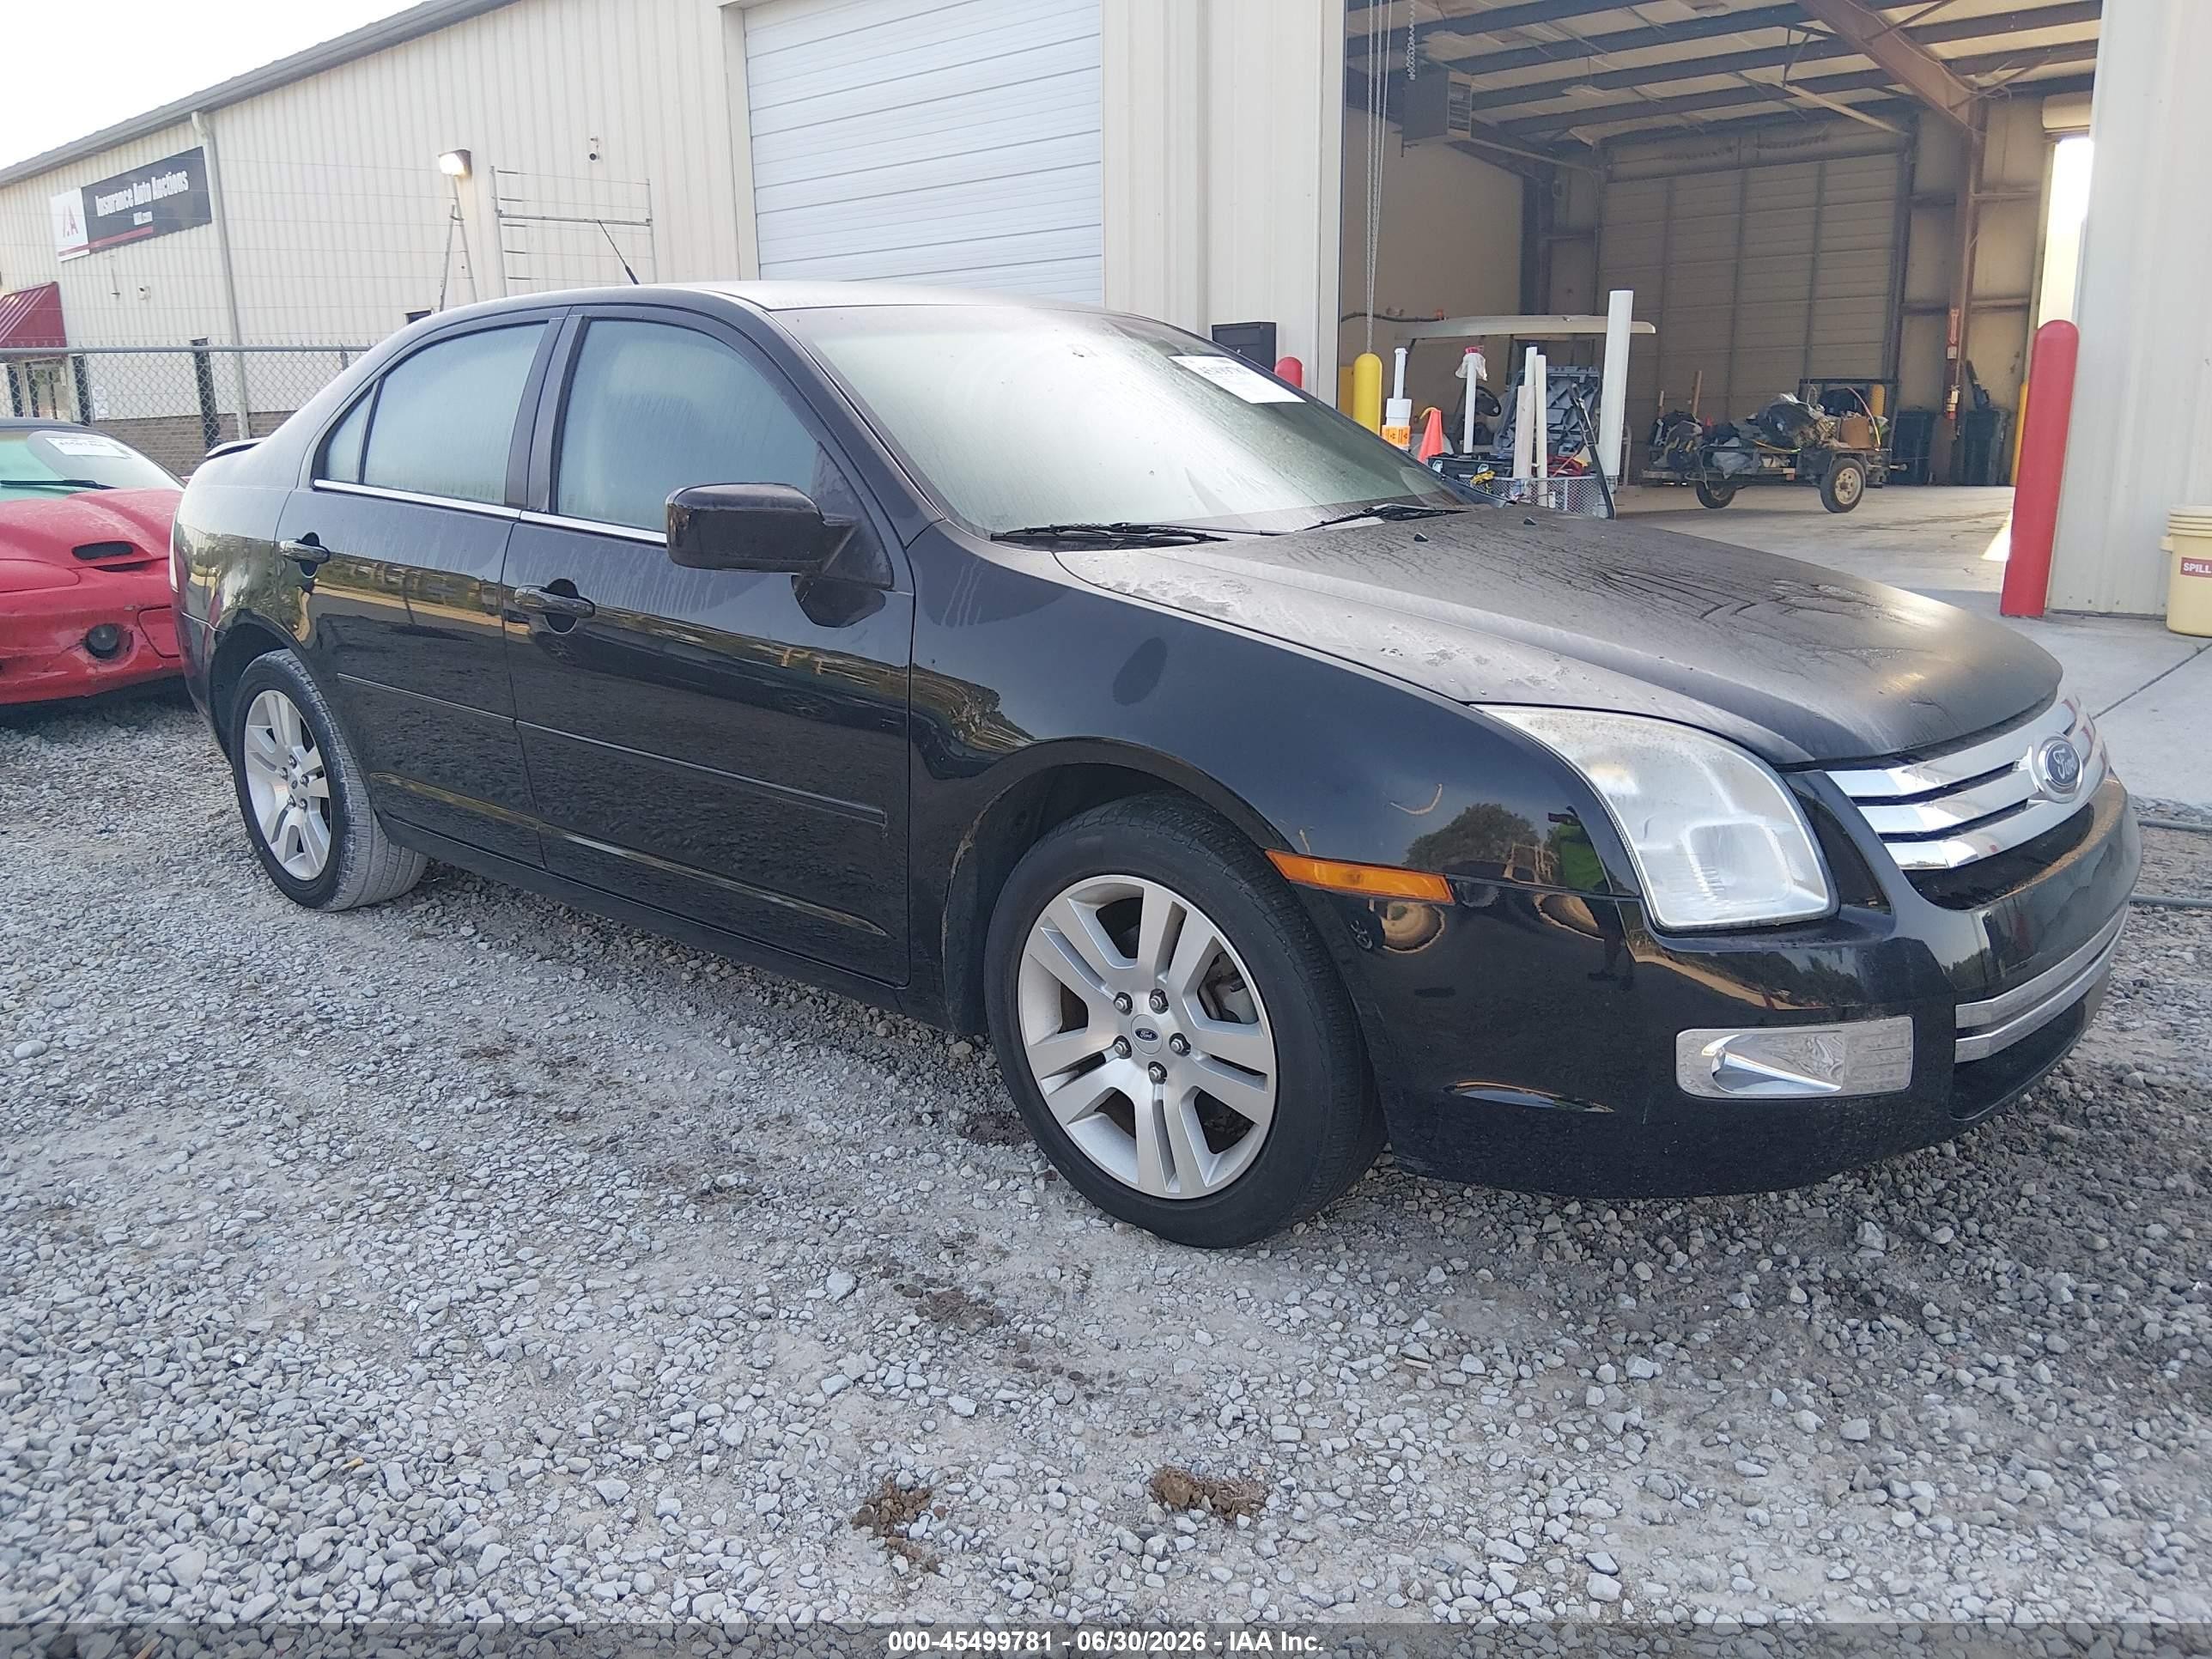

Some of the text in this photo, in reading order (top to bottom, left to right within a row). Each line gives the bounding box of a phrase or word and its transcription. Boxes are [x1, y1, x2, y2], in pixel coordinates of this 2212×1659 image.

[95, 170, 189, 217] Insurance Auto Auctions
[2183, 562, 2212, 574] SPILL
